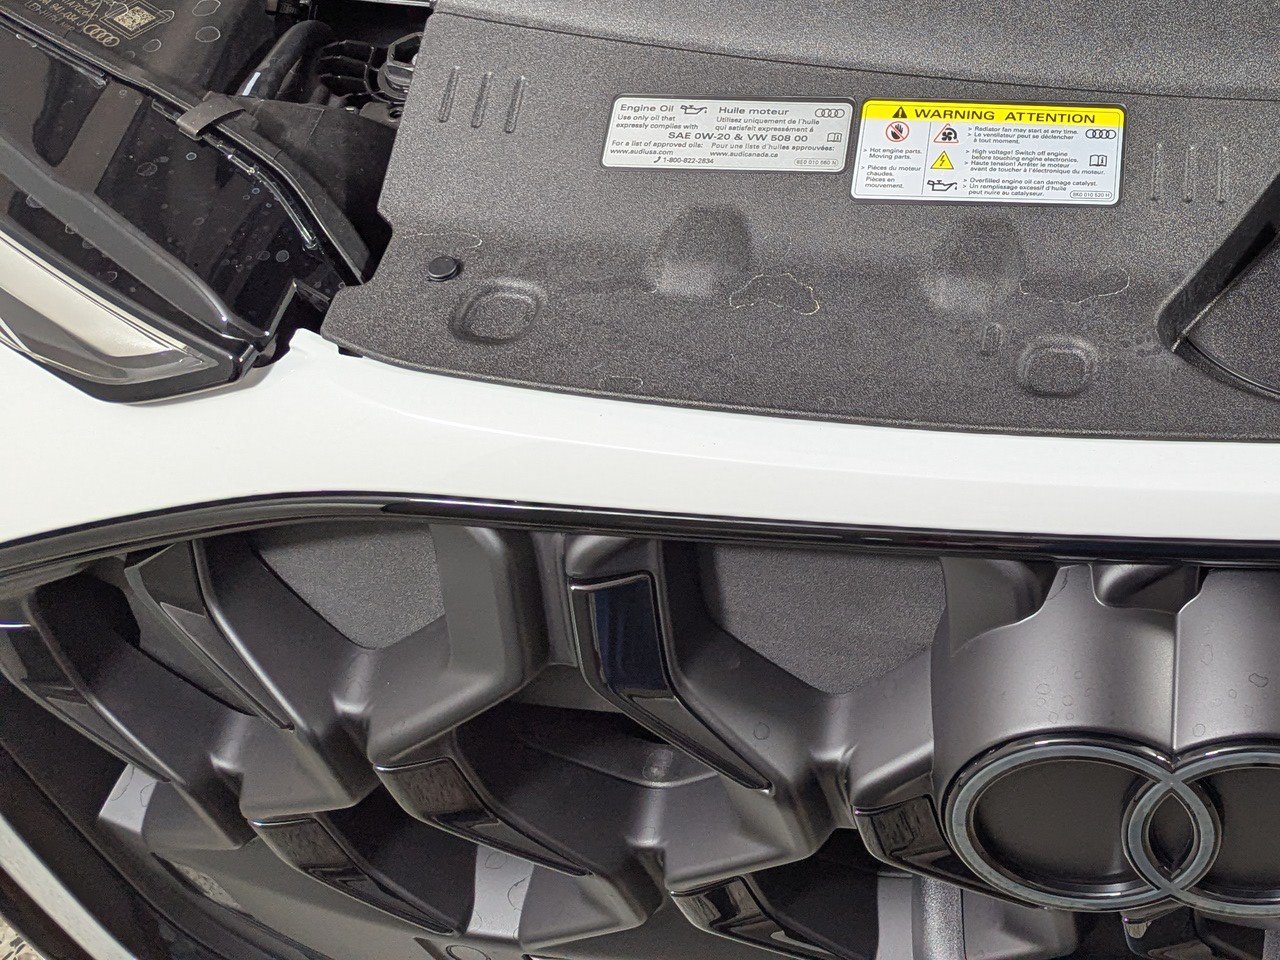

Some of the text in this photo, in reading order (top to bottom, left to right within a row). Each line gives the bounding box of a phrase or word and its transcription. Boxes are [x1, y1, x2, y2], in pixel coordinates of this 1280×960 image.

[620, 103, 674, 112] Engine Oil
[718, 106, 745, 114] Huile
[914, 108, 1094, 123] WARNING ATTENTION
[649, 122, 681, 130] complies
[667, 131, 691, 139] SAE
[694, 132, 730, 140] 0W-20
[747, 133, 767, 141] VW
[793, 134, 808, 142] 00
[882, 147, 903, 155] engine
[663, 156, 714, 164] 1-800-822-2834
[992, 154, 1020, 162] touching
[1045, 179, 1071, 187] damage
